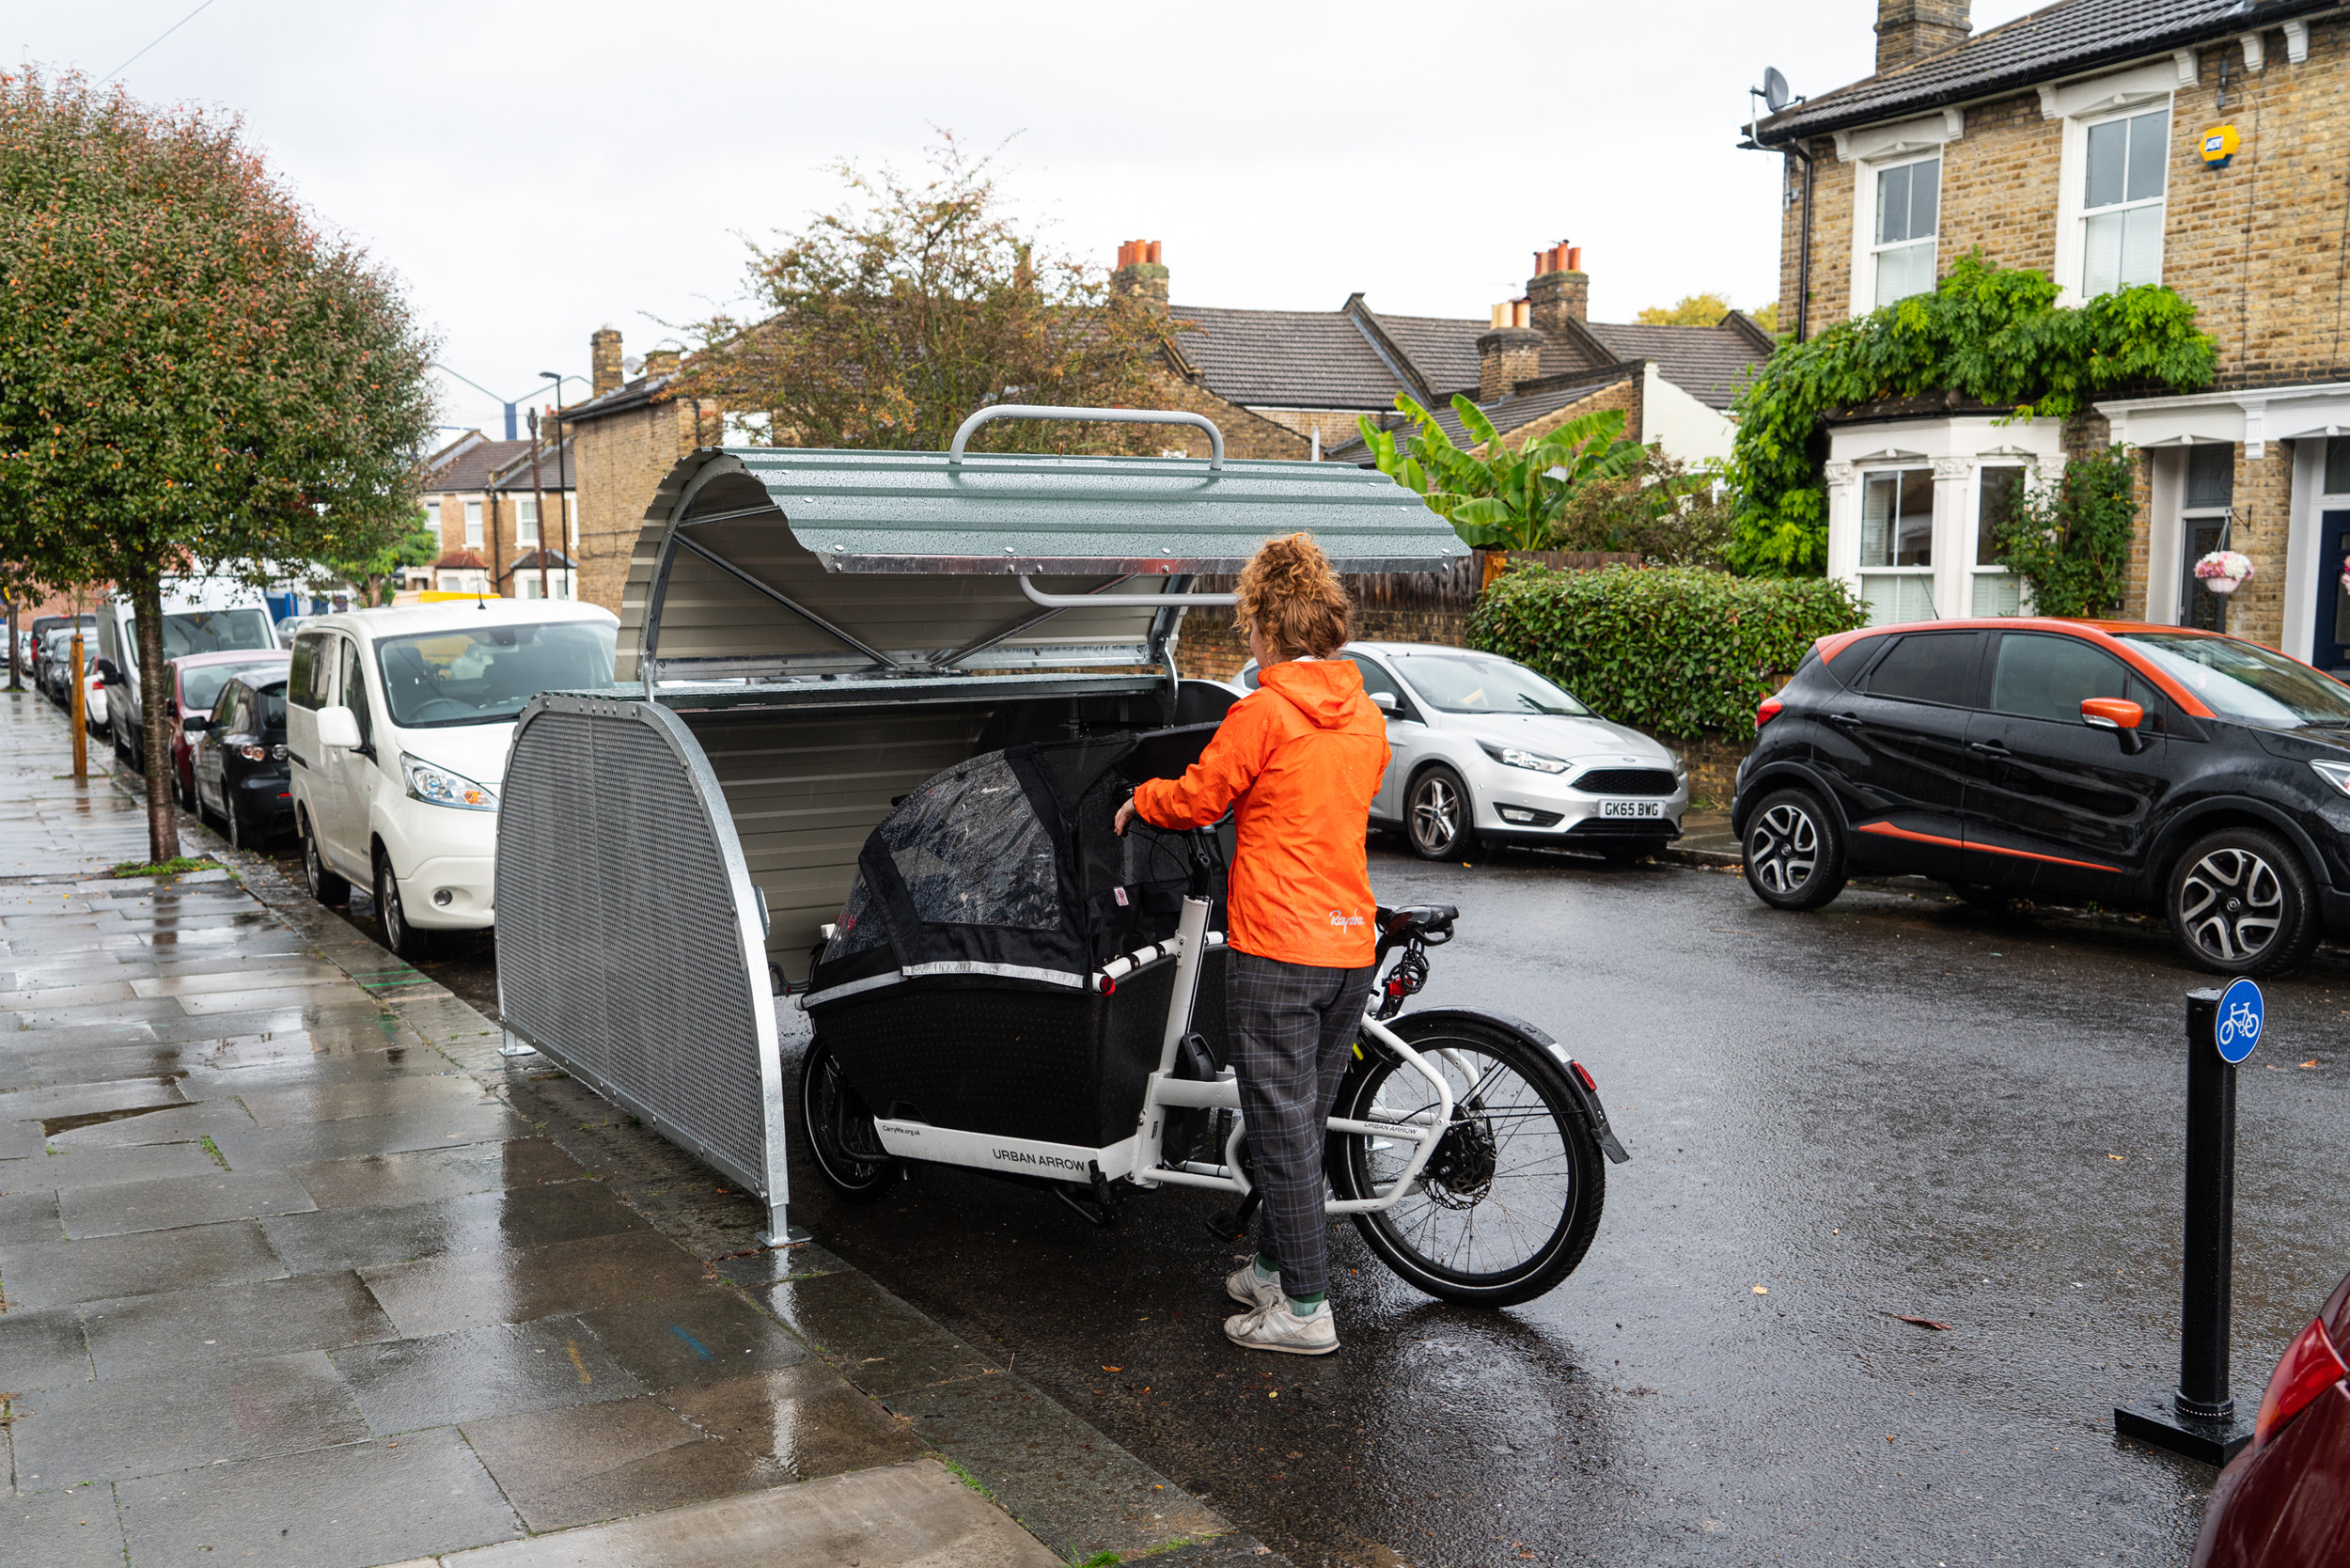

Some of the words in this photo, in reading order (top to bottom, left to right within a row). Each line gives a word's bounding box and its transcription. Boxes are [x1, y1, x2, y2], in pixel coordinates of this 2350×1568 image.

[2205, 137, 2221, 150] ADT
[1605, 802, 1635, 816] GK65
[1637, 803, 1659, 816] BWG
[882, 1125, 920, 1136] CarryMe.org.uk
[1364, 1121, 1389, 1131] URBAN
[992, 1148, 1036, 1165] URBAN
[1039, 1155, 1085, 1171] ARROW
